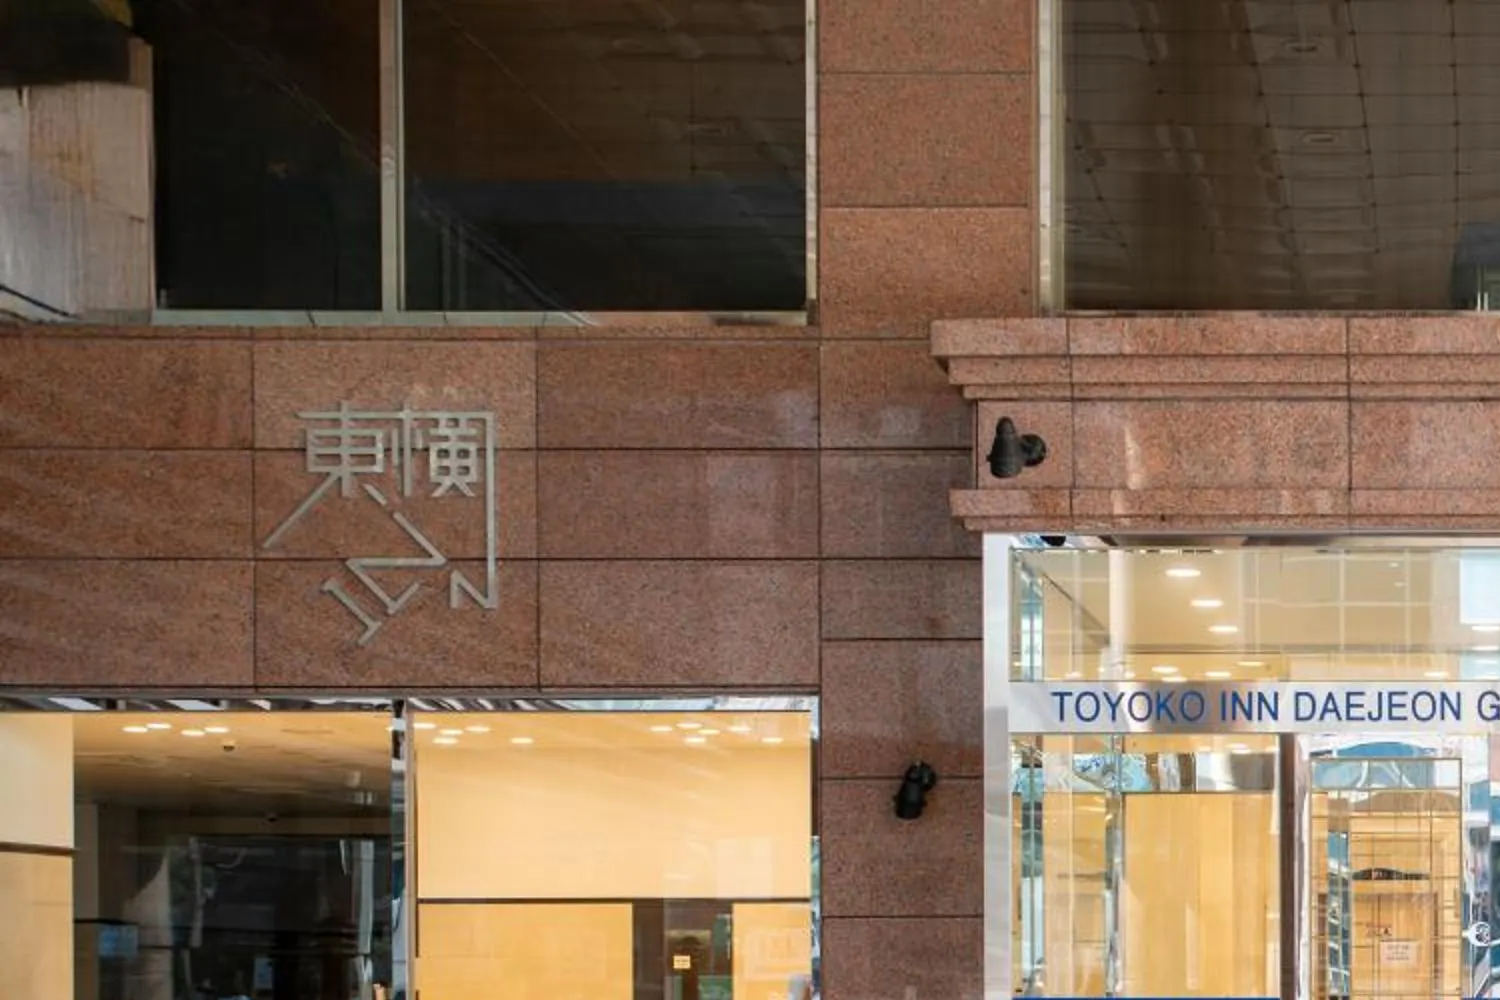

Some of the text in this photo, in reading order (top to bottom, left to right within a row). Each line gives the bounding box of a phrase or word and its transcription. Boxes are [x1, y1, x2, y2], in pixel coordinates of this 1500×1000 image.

[1051, 690, 1206, 722] TOYOKO
[1220, 691, 1279, 721] INN
[1294, 691, 1462, 722] DAEJEON
